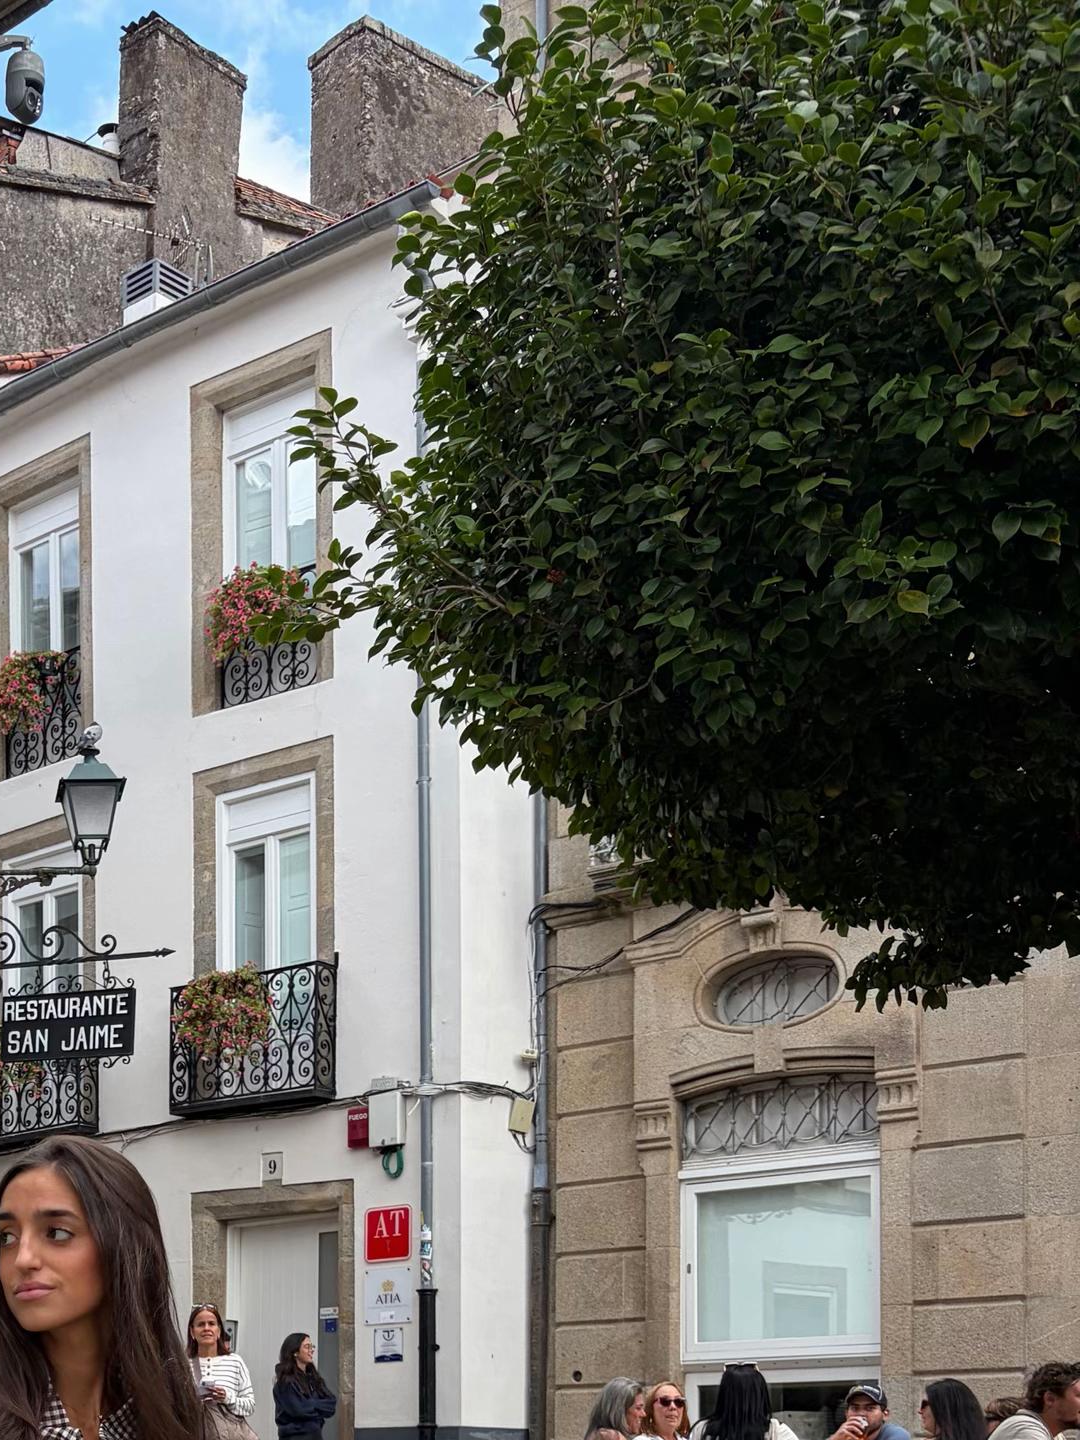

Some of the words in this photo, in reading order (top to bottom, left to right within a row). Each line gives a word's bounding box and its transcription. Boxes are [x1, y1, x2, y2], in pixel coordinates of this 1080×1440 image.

[3, 993, 129, 1022] RESTAURANTE
[7, 1028, 49, 1054] SAN
[61, 1024, 124, 1051] JAIME
[348, 1112, 368, 1121] FUEGO
[268, 1159, 277, 1175] 9
[373, 1209, 405, 1239] AT
[375, 1293, 401, 1305] ATIA
